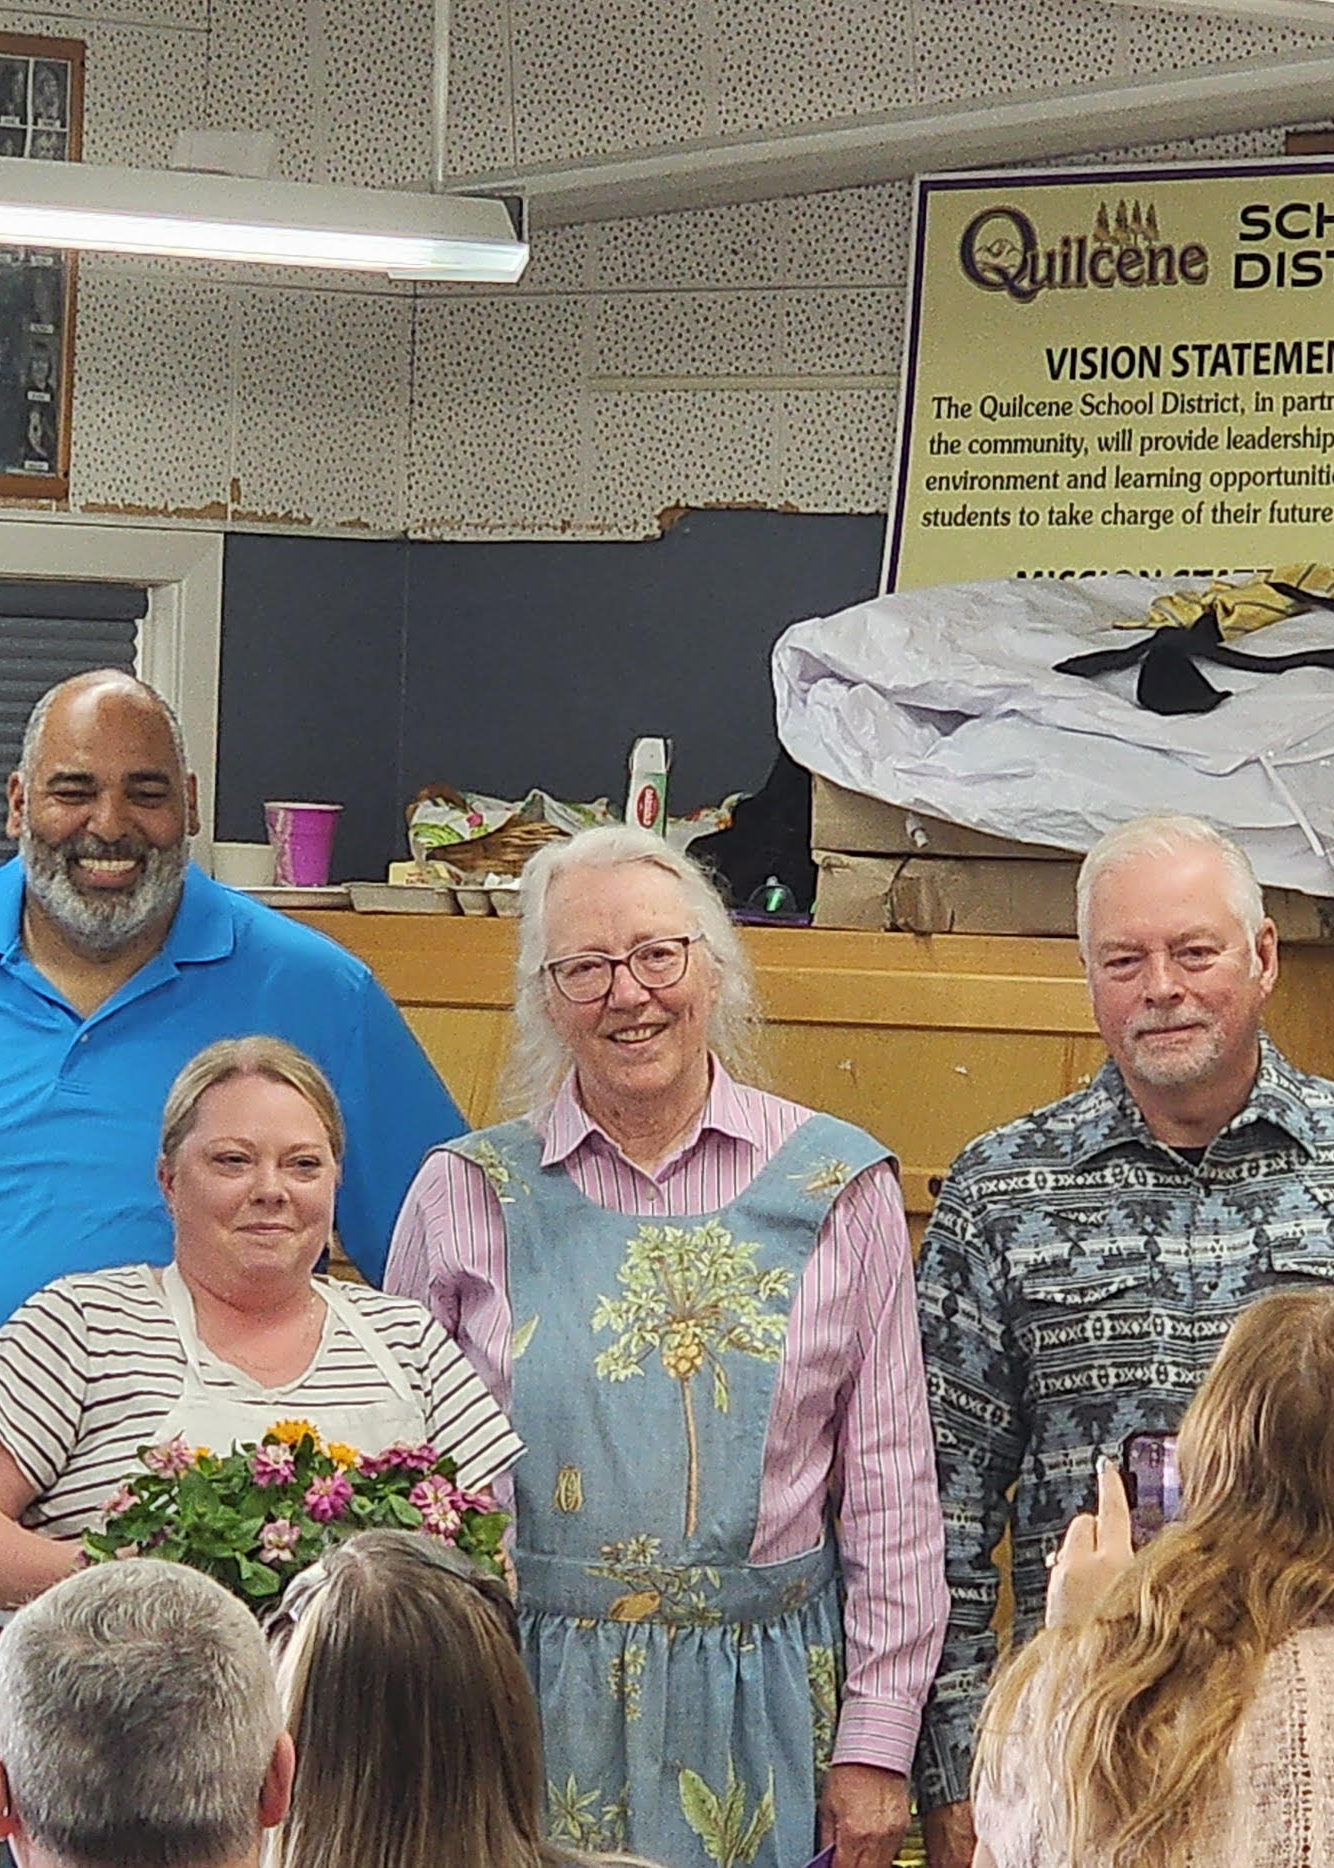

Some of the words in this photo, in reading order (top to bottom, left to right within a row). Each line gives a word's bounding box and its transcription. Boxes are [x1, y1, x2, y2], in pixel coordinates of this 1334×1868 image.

[960, 206, 1208, 303] Quilcene
[1045, 345, 1162, 381] VISION
[932, 396, 972, 419] The
[980, 394, 1073, 422] Quilcene
[1080, 391, 1153, 417] School
[1160, 391, 1246, 415] District,
[1254, 391, 1274, 413] in
[929, 432, 961, 456] the
[968, 432, 1089, 458] community,
[1097, 428, 1133, 452] will
[1139, 427, 1220, 456] provide
[925, 470, 1059, 491] environment
[1066, 466, 1107, 490] and
[1114, 465, 1202, 493] learning
[921, 504, 1011, 528] students
[1018, 506, 1040, 526] to
[1047, 503, 1094, 526] take
[1101, 502, 1174, 530] charge
[1181, 501, 1205, 525] of
[1211, 501, 1262, 525] their
